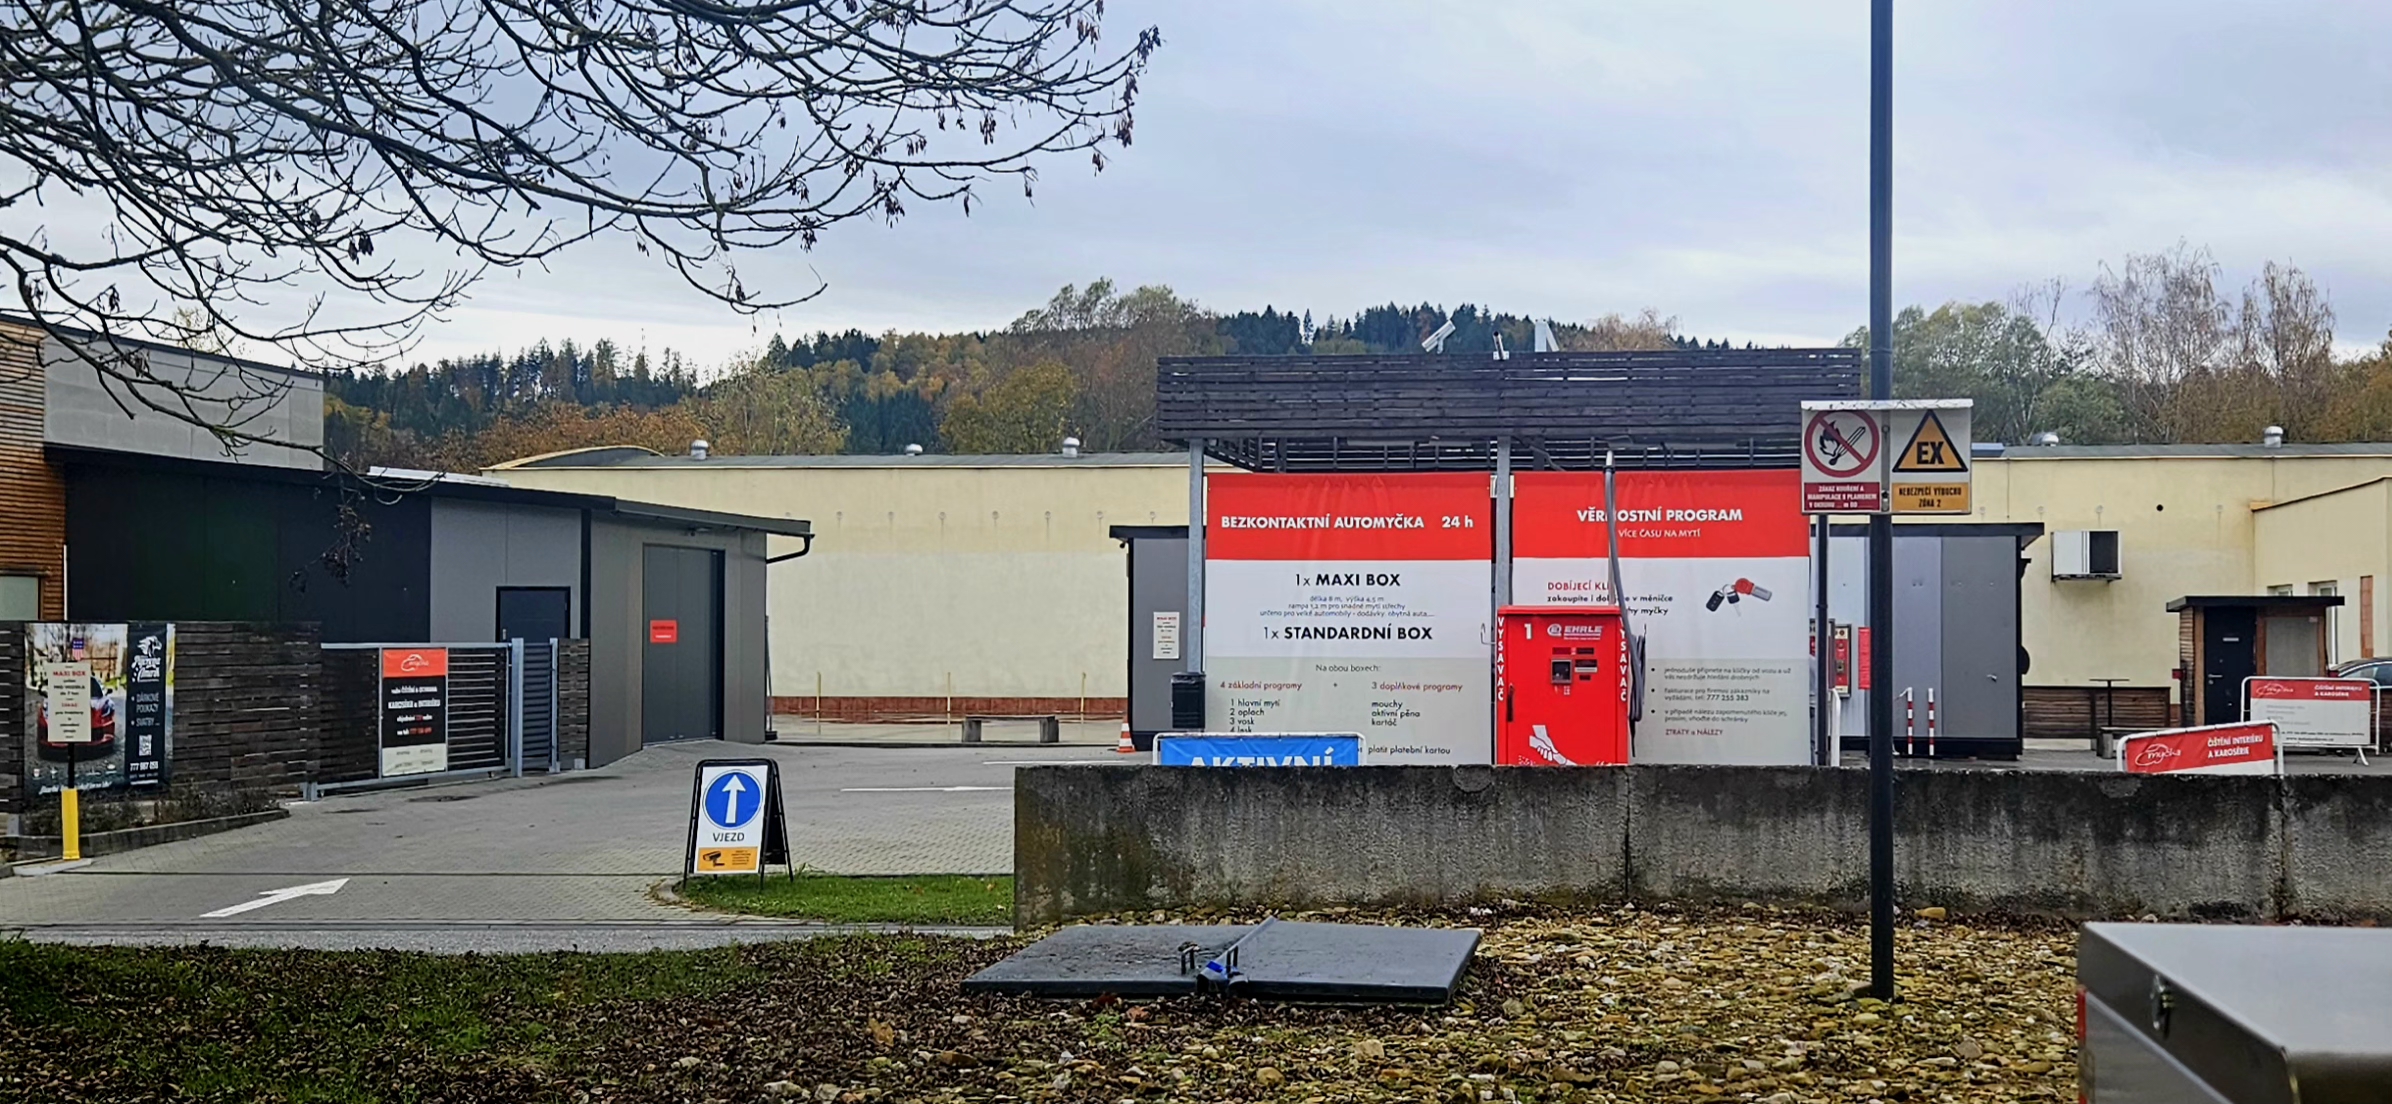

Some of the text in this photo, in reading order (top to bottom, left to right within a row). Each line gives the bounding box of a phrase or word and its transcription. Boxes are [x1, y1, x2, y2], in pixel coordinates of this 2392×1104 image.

[1917, 441, 1944, 465] EX
[1899, 485, 1962, 496] NEBEZPEČÍ VÝBUCHU
[1918, 498, 1941, 508] ZÓNA 2
[1577, 506, 1743, 523] VĚROSTNÍ PROGRAM
[1221, 513, 1474, 529] BEZKONTAKTNÍ AUTOMYČKA 24 h
[1618, 527, 1700, 538] VÍCE ČASU NA MYTÍ
[1315, 573, 1360, 586] MAXI
[1366, 573, 1401, 586] BOX
[1547, 579, 1592, 591] DOBÍJECÍ
[1640, 594, 1673, 602] měničce
[1314, 609, 1351, 618] automobily
[1641, 606, 1669, 616] myčky
[1284, 622, 1392, 640] STANDARDNÍ
[1397, 626, 1433, 640] BOX
[1524, 623, 1532, 640] 1
[1564, 625, 1603, 634] EHRLE
[1316, 664, 1327, 672] Na
[1329, 664, 1349, 672] obou
[1228, 681, 1262, 689] základní
[1264, 683, 1302, 691] programy
[1371, 681, 1463, 693] 3 doplňkové programy
[1230, 698, 1234, 706] 1
[1238, 698, 1261, 707] hlavní
[1371, 699, 1403, 710] mouchy
[1229, 707, 1265, 717] 2 oplach
[1371, 709, 1421, 719] aktivní pěna
[1229, 717, 1255, 725] 3 vosk
[1371, 718, 1397, 726] kartáč
[2207, 736, 2232, 747] ČIŠTĚNÍ
[2232, 733, 2263, 745] INTERIÉRU
[1390, 744, 1423, 755] platební
[1424, 744, 1451, 754] kartou
[2207, 746, 2250, 759] A KAROSÉRIE
[712, 832, 745, 842] VJEZD
